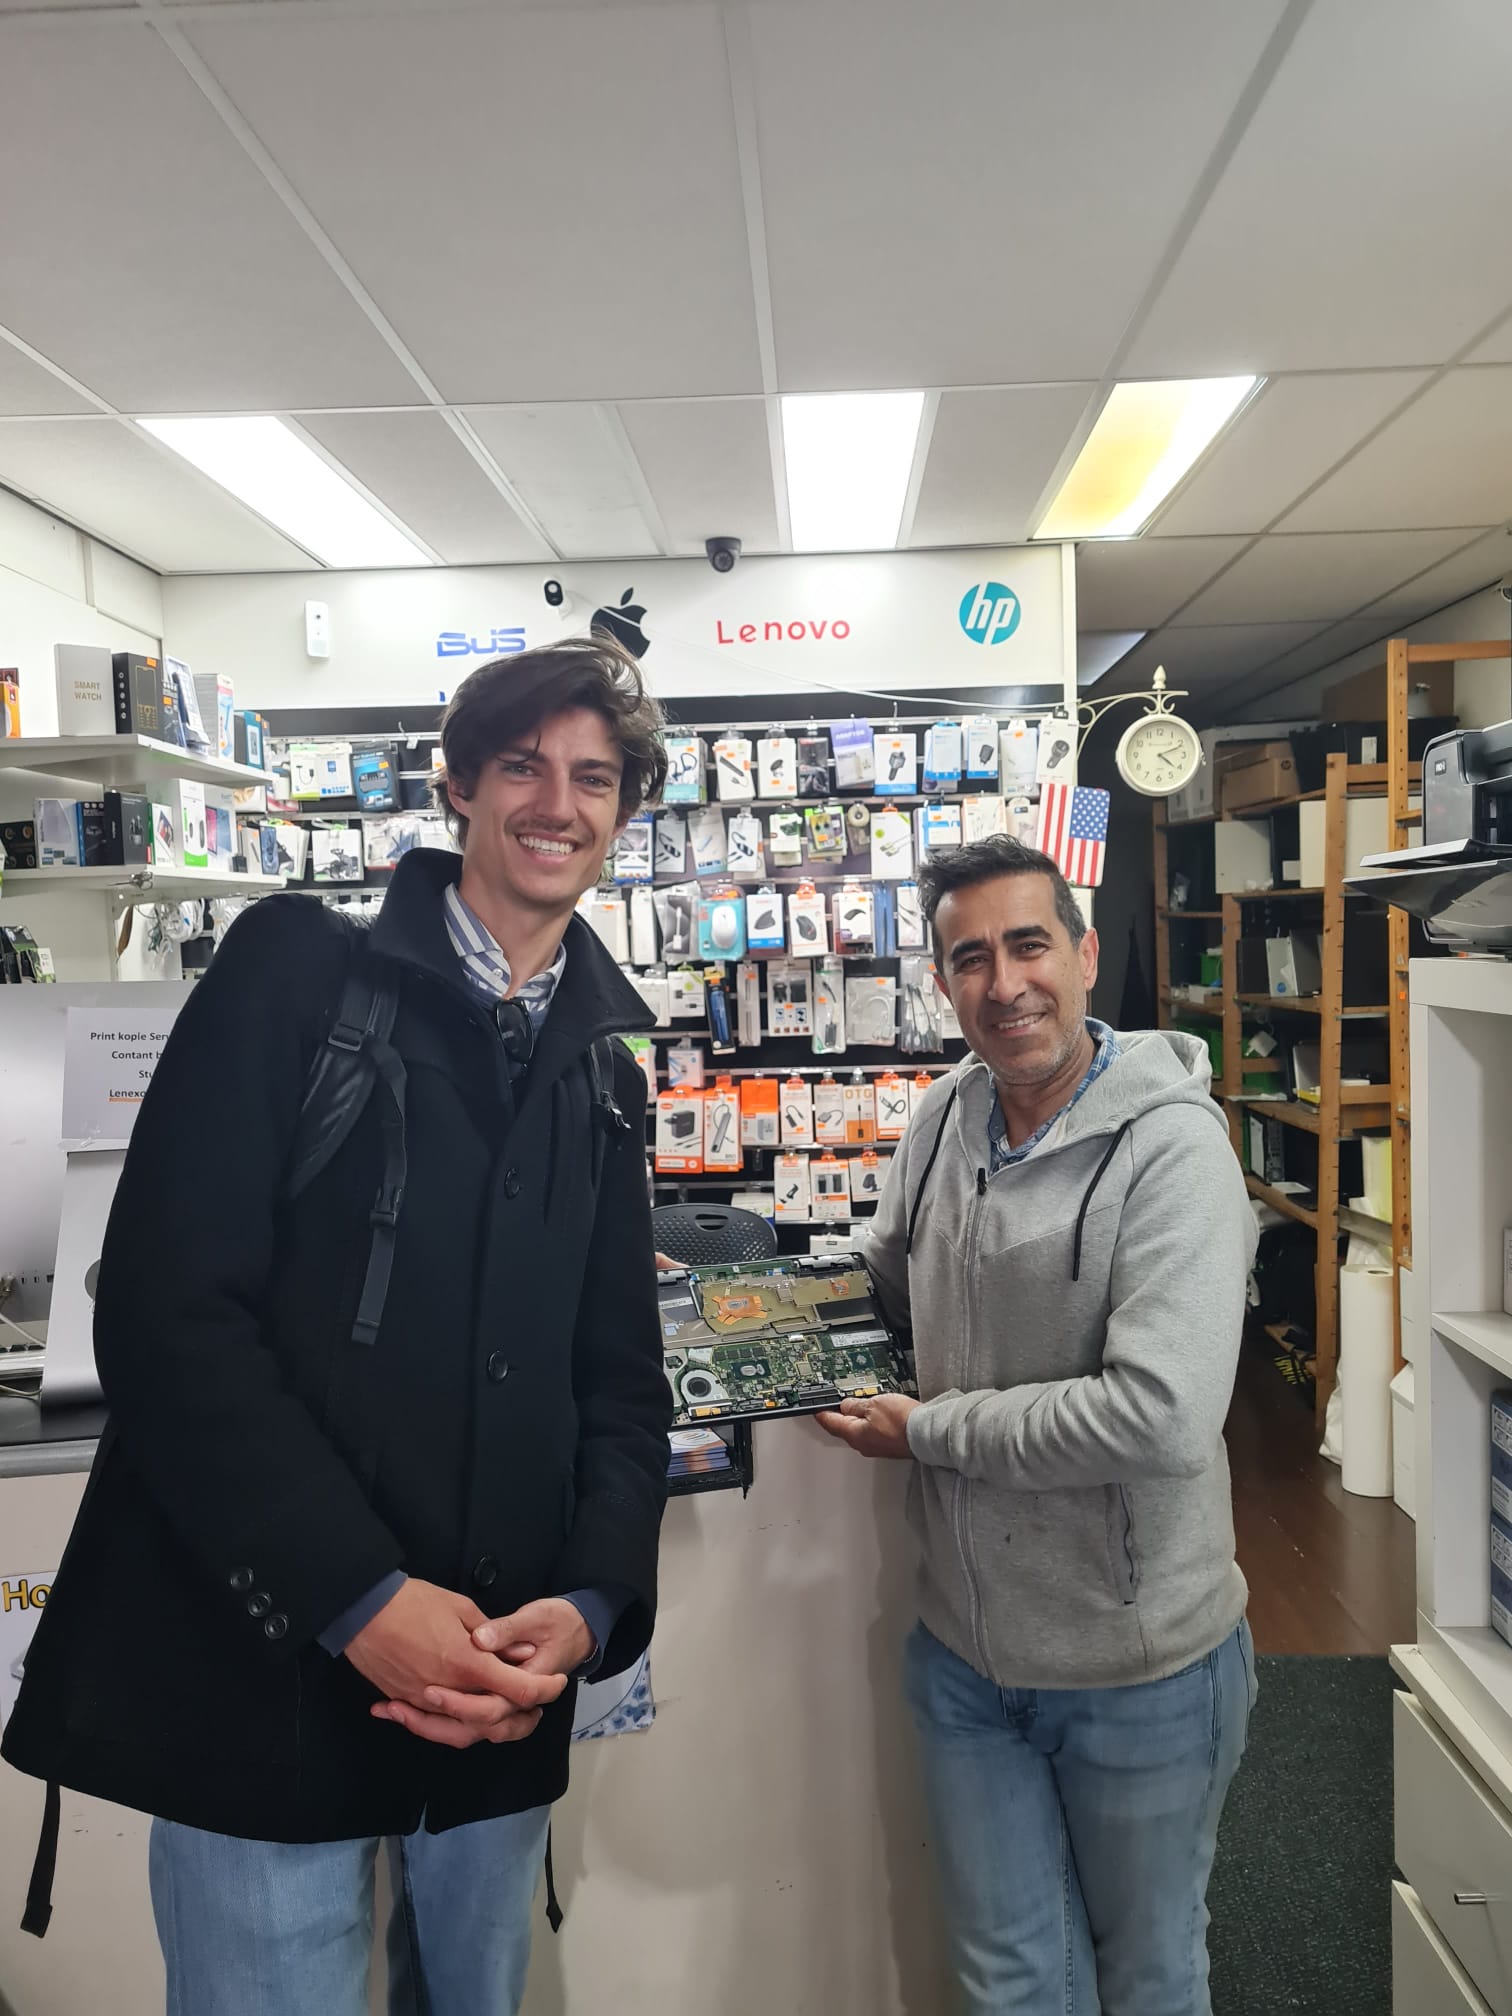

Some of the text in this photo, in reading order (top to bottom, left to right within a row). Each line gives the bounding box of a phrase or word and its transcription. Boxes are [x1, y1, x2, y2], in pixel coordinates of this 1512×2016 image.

[960, 582, 1021, 645] hp
[716, 619, 850, 645] Lenovo
[74, 680, 100, 690] SMART
[74, 691, 102, 701] WATCH
[1156, 728, 1164, 737] 12
[90, 1032, 115, 1041] Print
[118, 1032, 147, 1042] kopie
[111, 1050, 153, 1060] Contant
[845, 1088, 873, 1100] OTG
